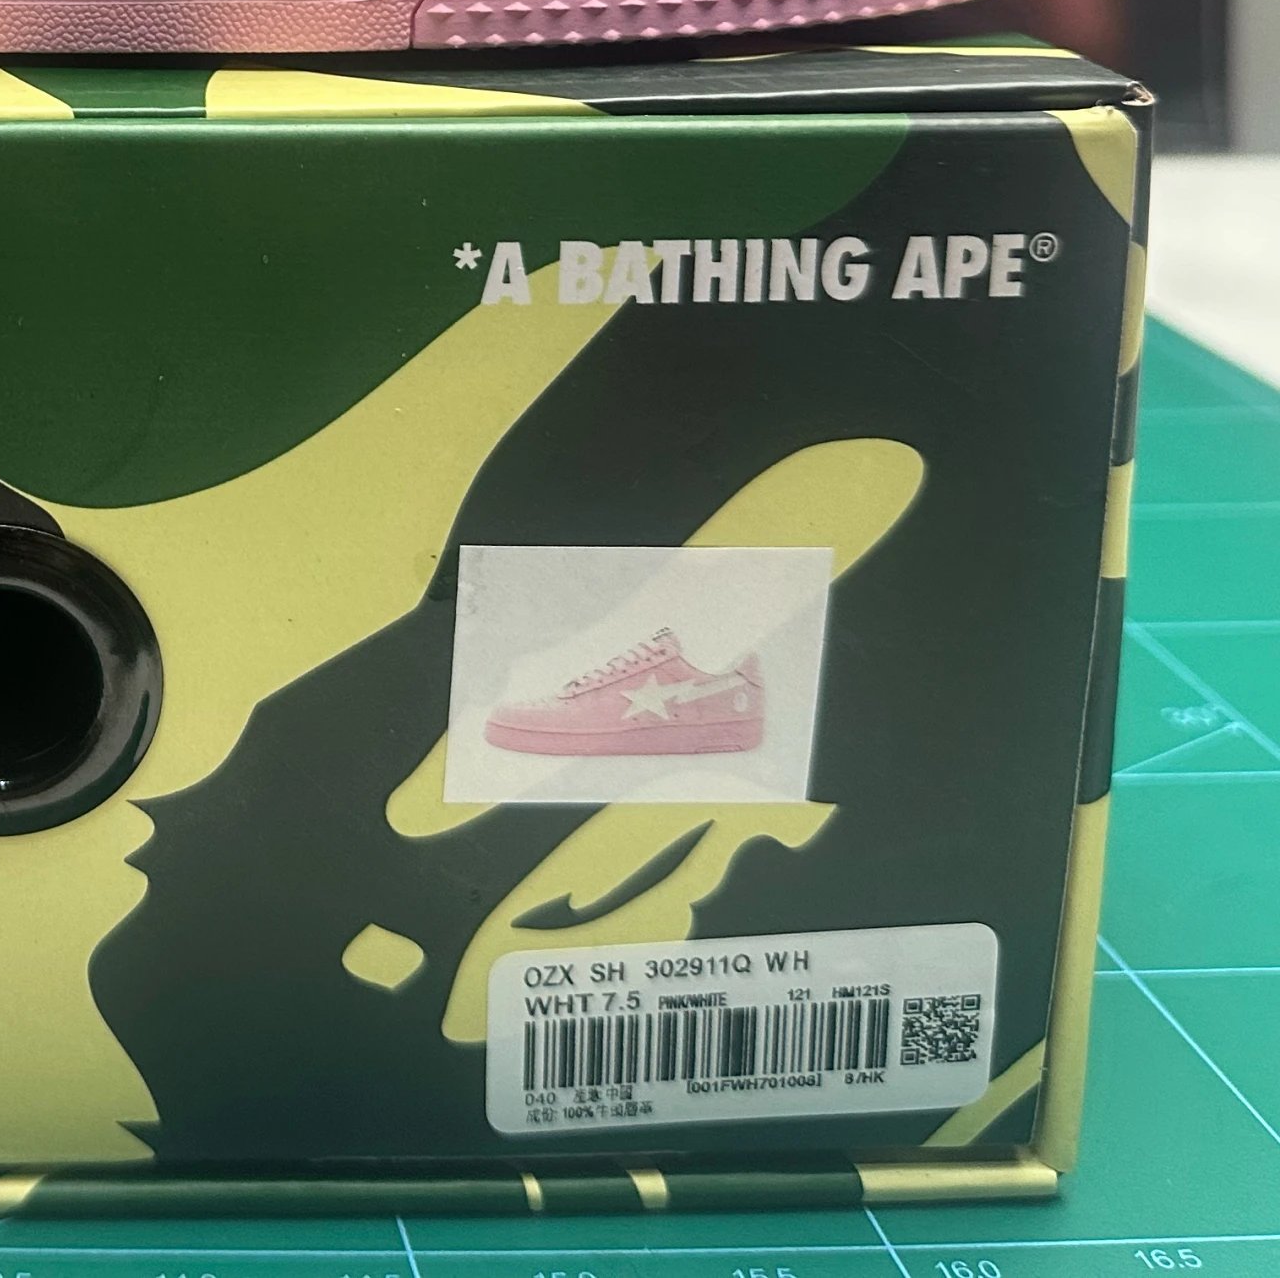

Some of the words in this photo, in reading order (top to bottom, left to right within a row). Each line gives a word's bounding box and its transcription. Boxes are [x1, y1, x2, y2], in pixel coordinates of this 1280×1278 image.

[559, 236, 873, 305] BATHING
[524, 963, 575, 988] OZX
[591, 961, 626, 984] SH
[645, 955, 752, 980] 302911Q
[525, 993, 593, 1017] WHT
[604, 990, 641, 1011] 7.5
[658, 992, 728, 1010] PINK/WHITE
[787, 988, 811, 1001] 121
[1135, 1248, 1203, 1270] 16.5
